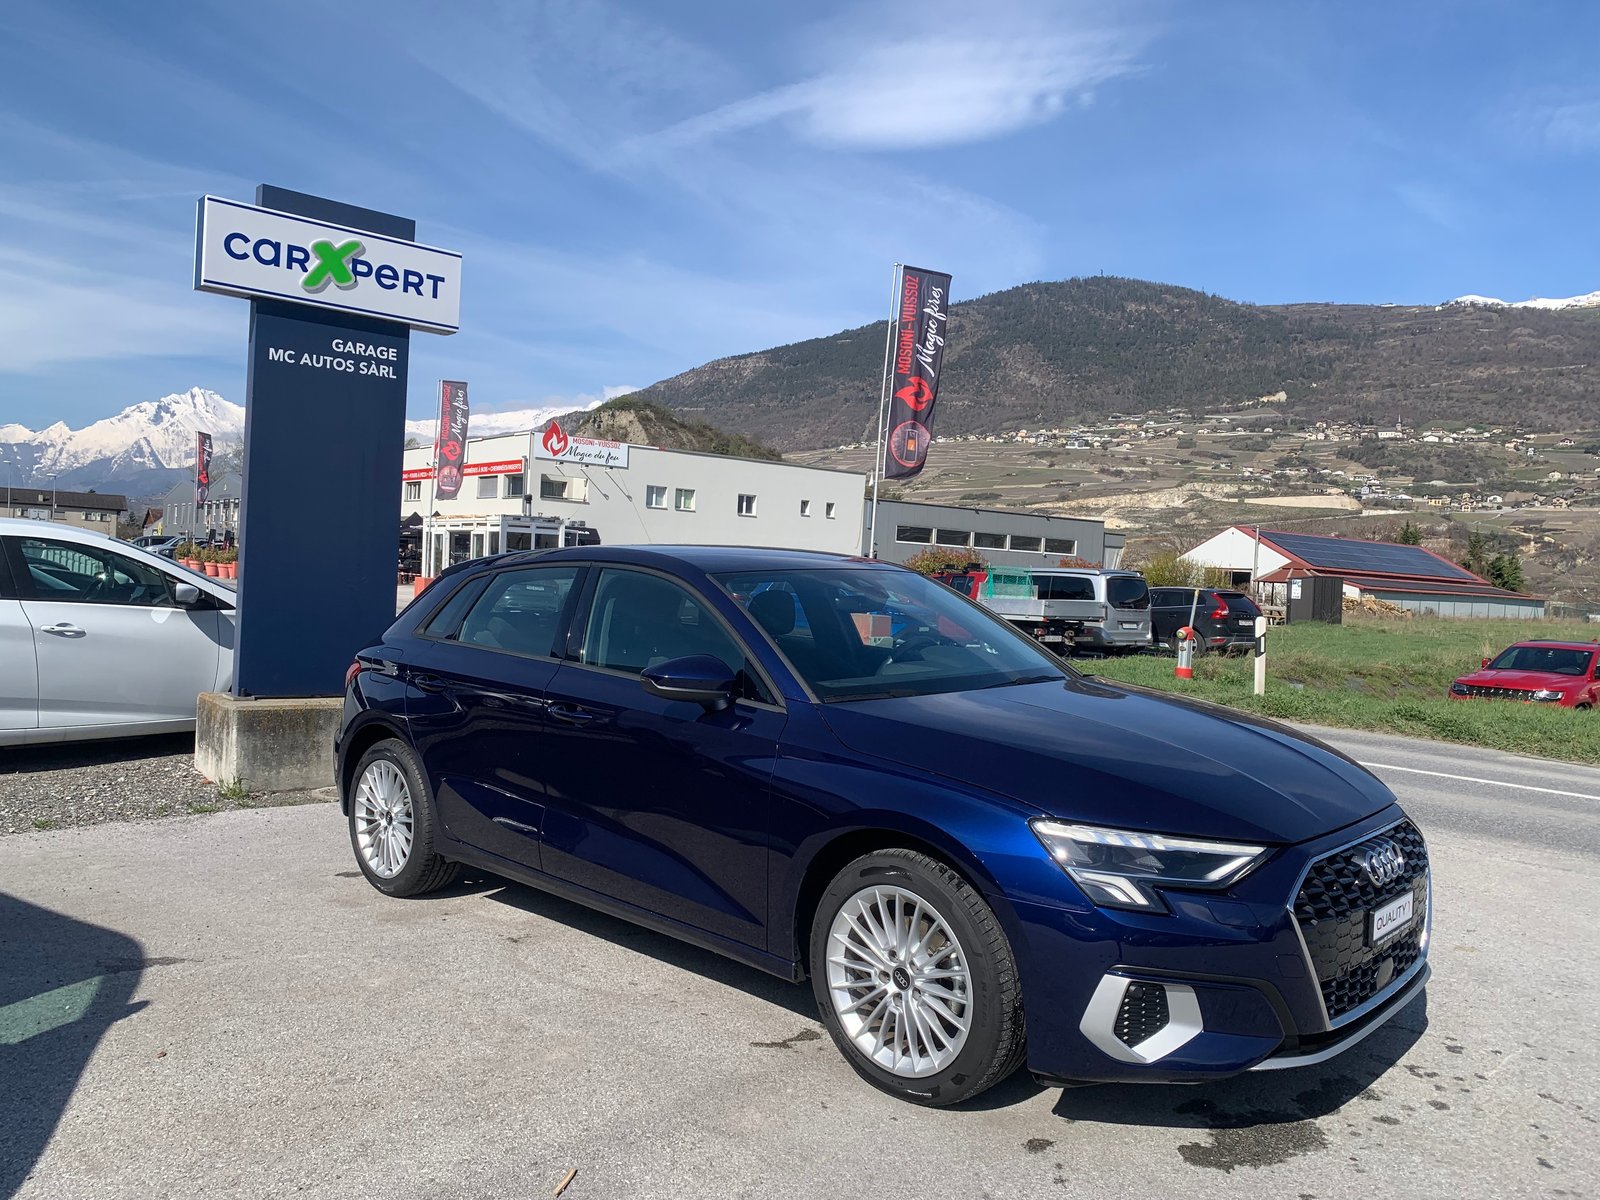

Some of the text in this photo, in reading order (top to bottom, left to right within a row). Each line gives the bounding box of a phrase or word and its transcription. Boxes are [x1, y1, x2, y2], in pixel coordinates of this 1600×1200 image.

[897, 274, 919, 375] MOSONI-VUISSOZ
[915, 286, 947, 378] Magic fires
[268, 347, 397, 379] MC AUTOS SÀRL
[332, 339, 397, 361] GARAGE
[450, 389, 469, 442] Magic fires
[561, 445, 619, 465] Magie du feu
[572, 437, 621, 450] MOSONI-VUISSOZ
